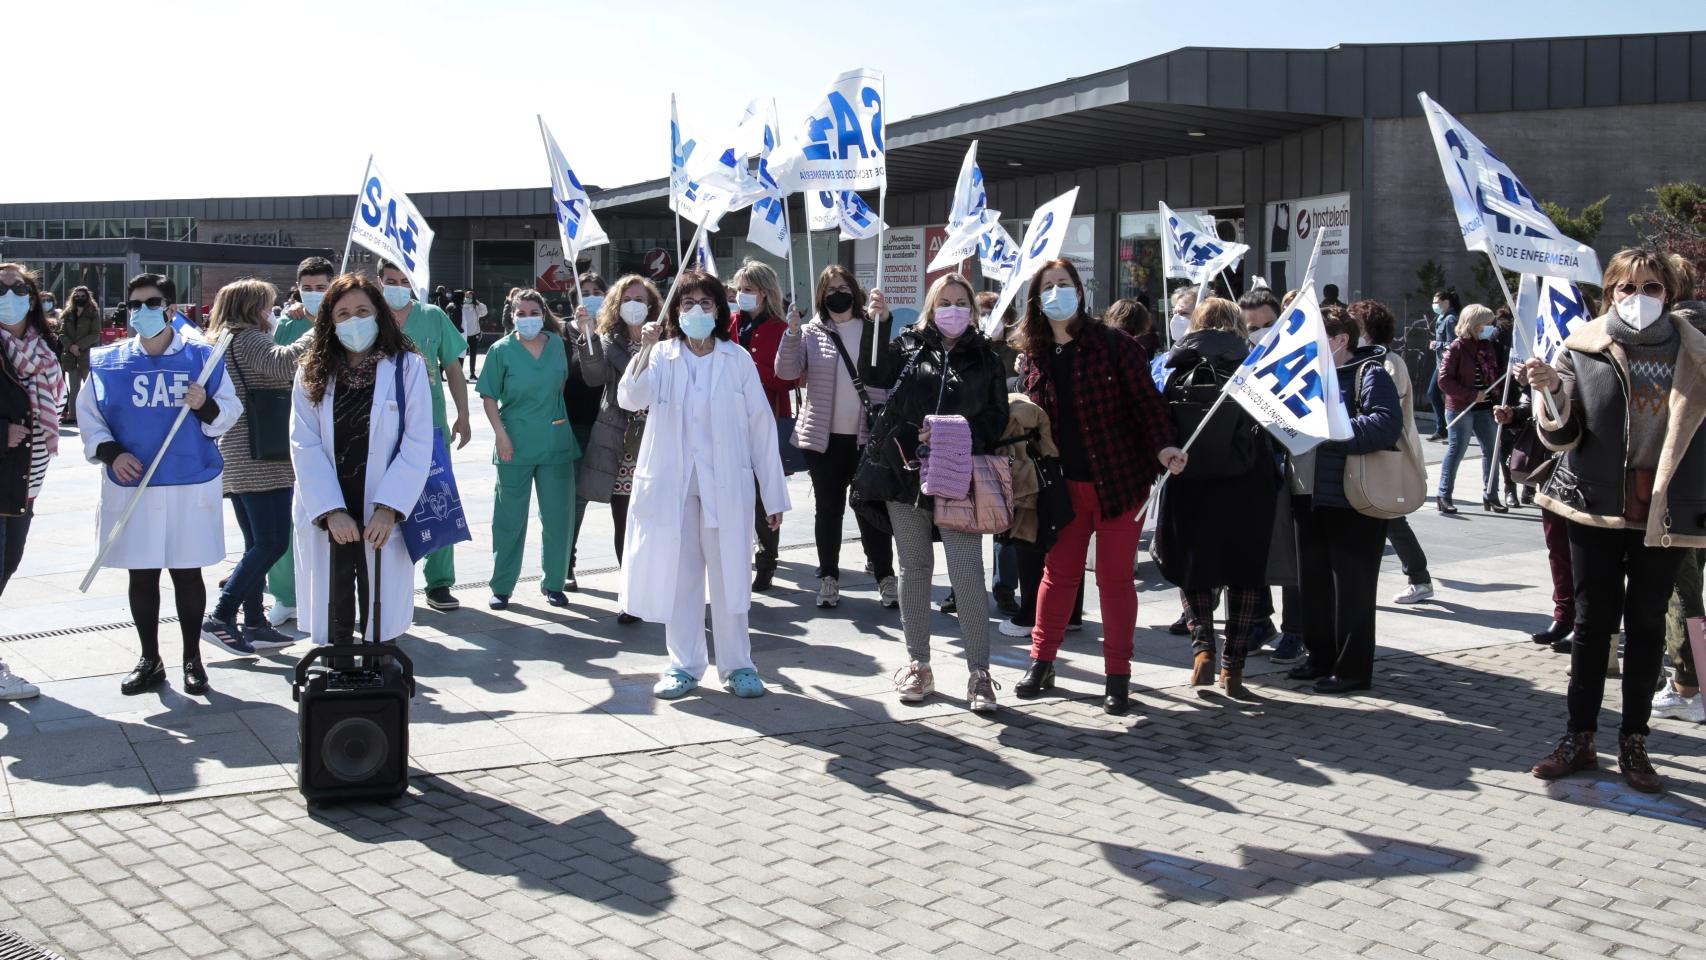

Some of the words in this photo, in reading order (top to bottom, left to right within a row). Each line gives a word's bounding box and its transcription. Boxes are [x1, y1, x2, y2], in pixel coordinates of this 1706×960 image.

[1312, 204, 1350, 229] hosteleón
[1506, 247, 1518, 259] DE
[1520, 249, 1579, 267] ENFERMERÍA
